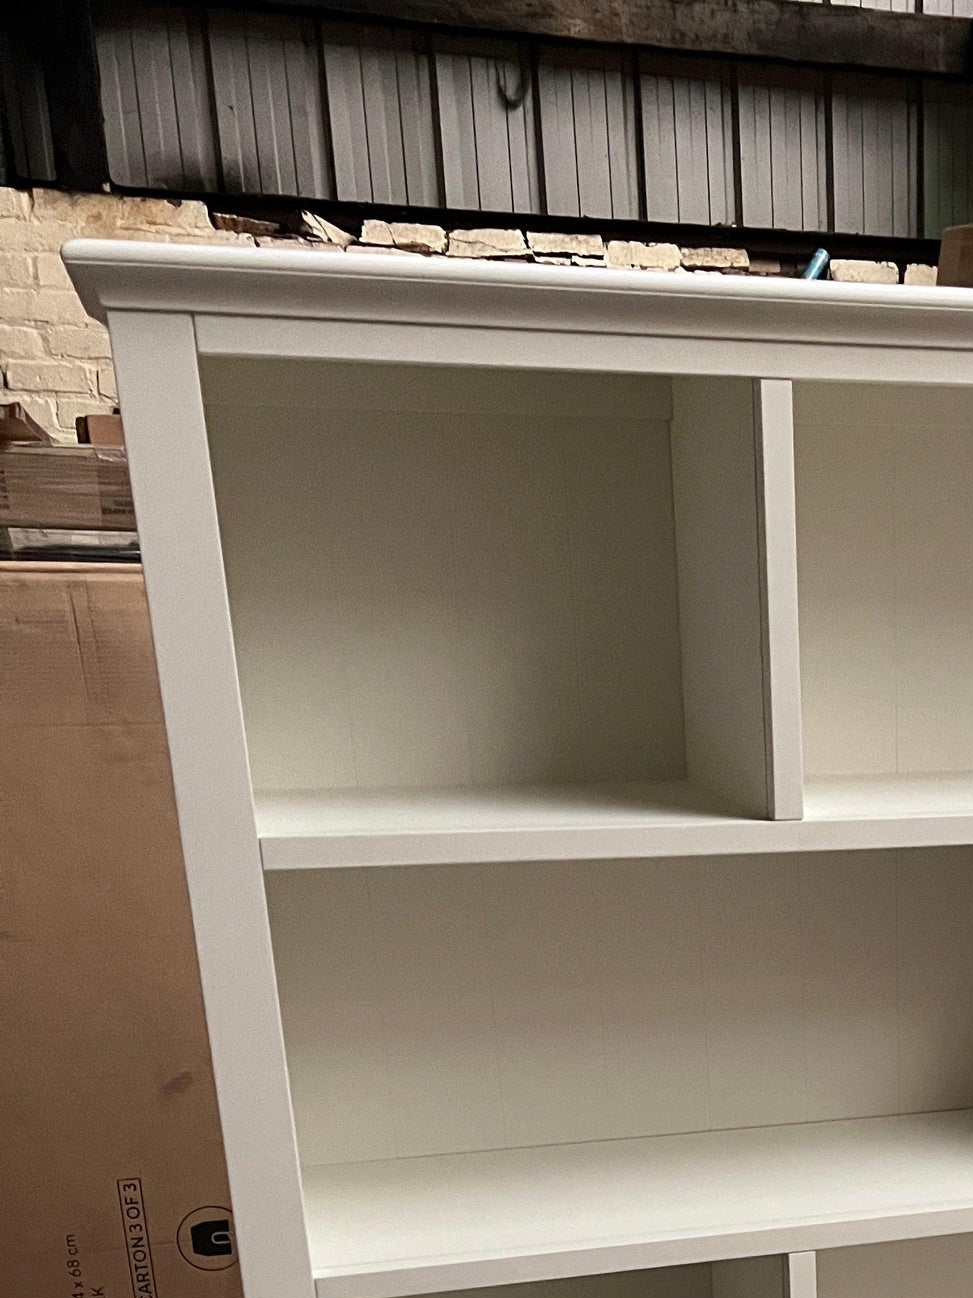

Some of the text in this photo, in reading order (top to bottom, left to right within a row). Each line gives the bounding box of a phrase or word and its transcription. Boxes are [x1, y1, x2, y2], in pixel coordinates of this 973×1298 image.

[123, 1183, 136, 1191] 3
[124, 1197, 140, 1219] OF
[129, 1224, 142, 1232] 3
[66, 1234, 78, 1255] cm
[67, 1260, 81, 1277] 68
